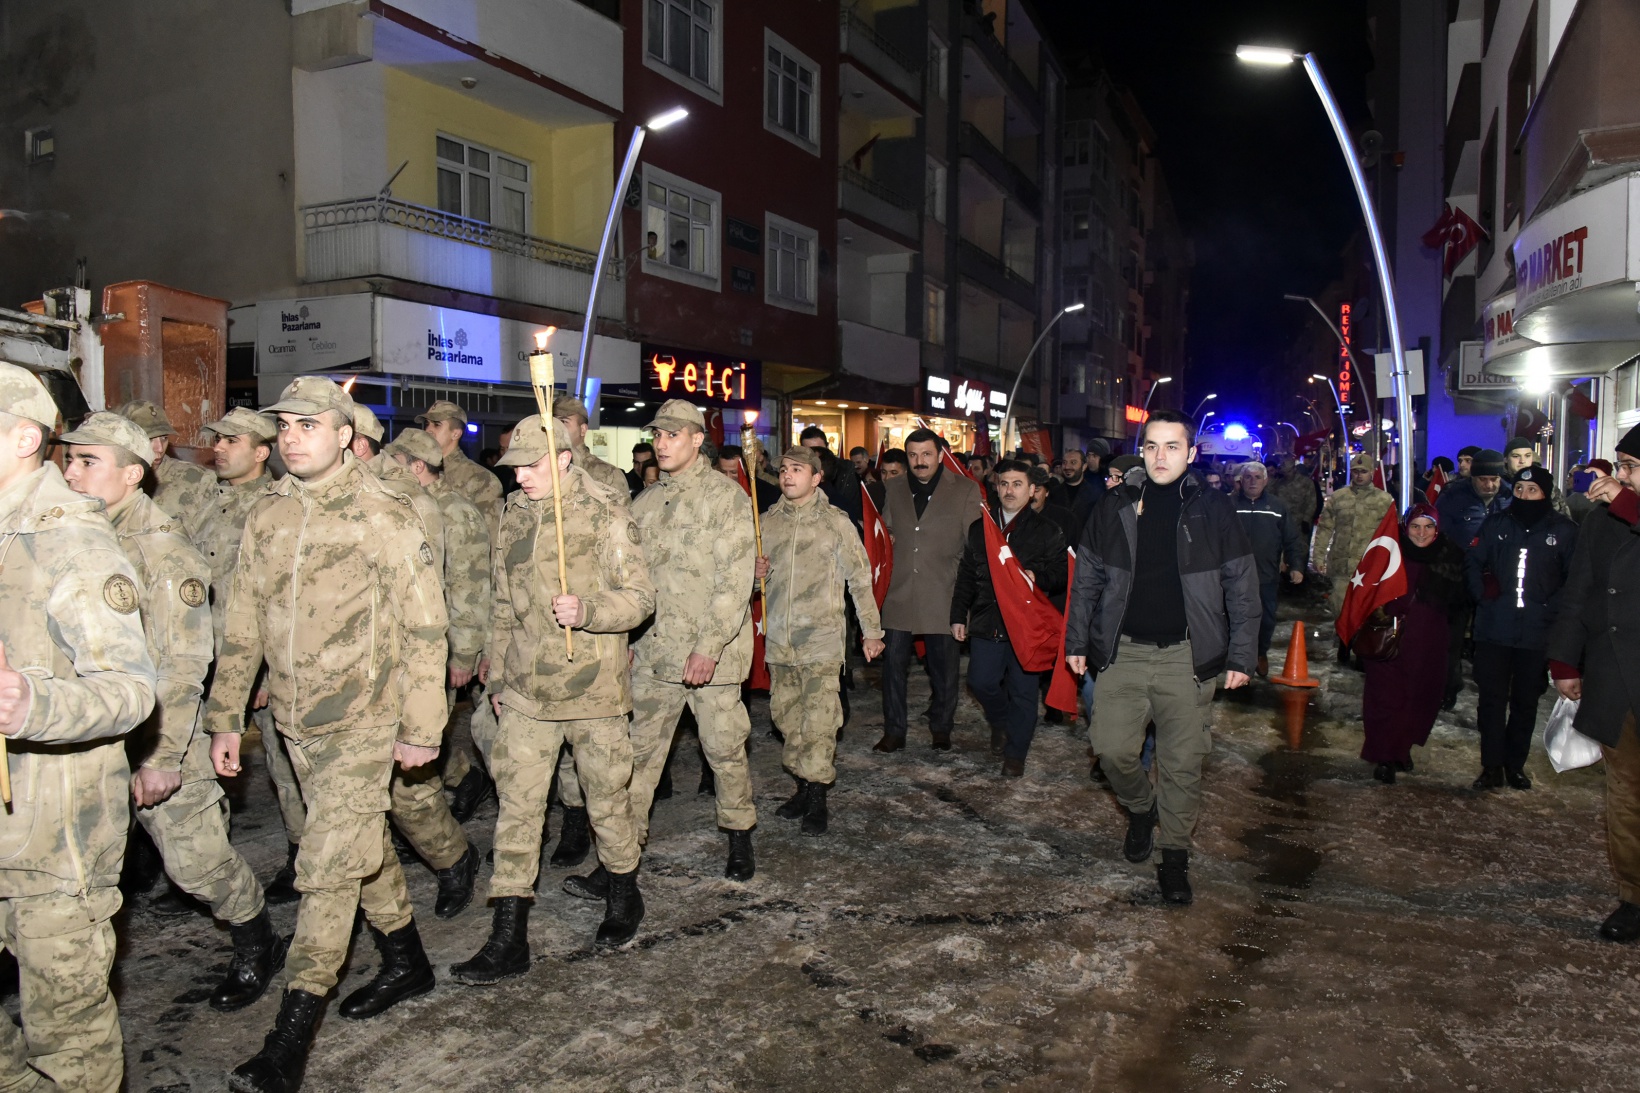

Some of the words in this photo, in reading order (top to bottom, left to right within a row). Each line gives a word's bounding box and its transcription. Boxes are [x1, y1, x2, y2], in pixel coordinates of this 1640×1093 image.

[1528, 226, 1588, 294] MARKET
[281, 310, 299, 323] İhlas
[281, 320, 321, 332] Pazarlama
[311, 340, 337, 351] Cebilon
[427, 329, 454, 349] İhlas
[268, 344, 297, 354] Cleanmax
[427, 347, 483, 366] Pazarlama
[683, 361, 746, 402] etçi
[1516, 547, 1528, 608] ZABITA
